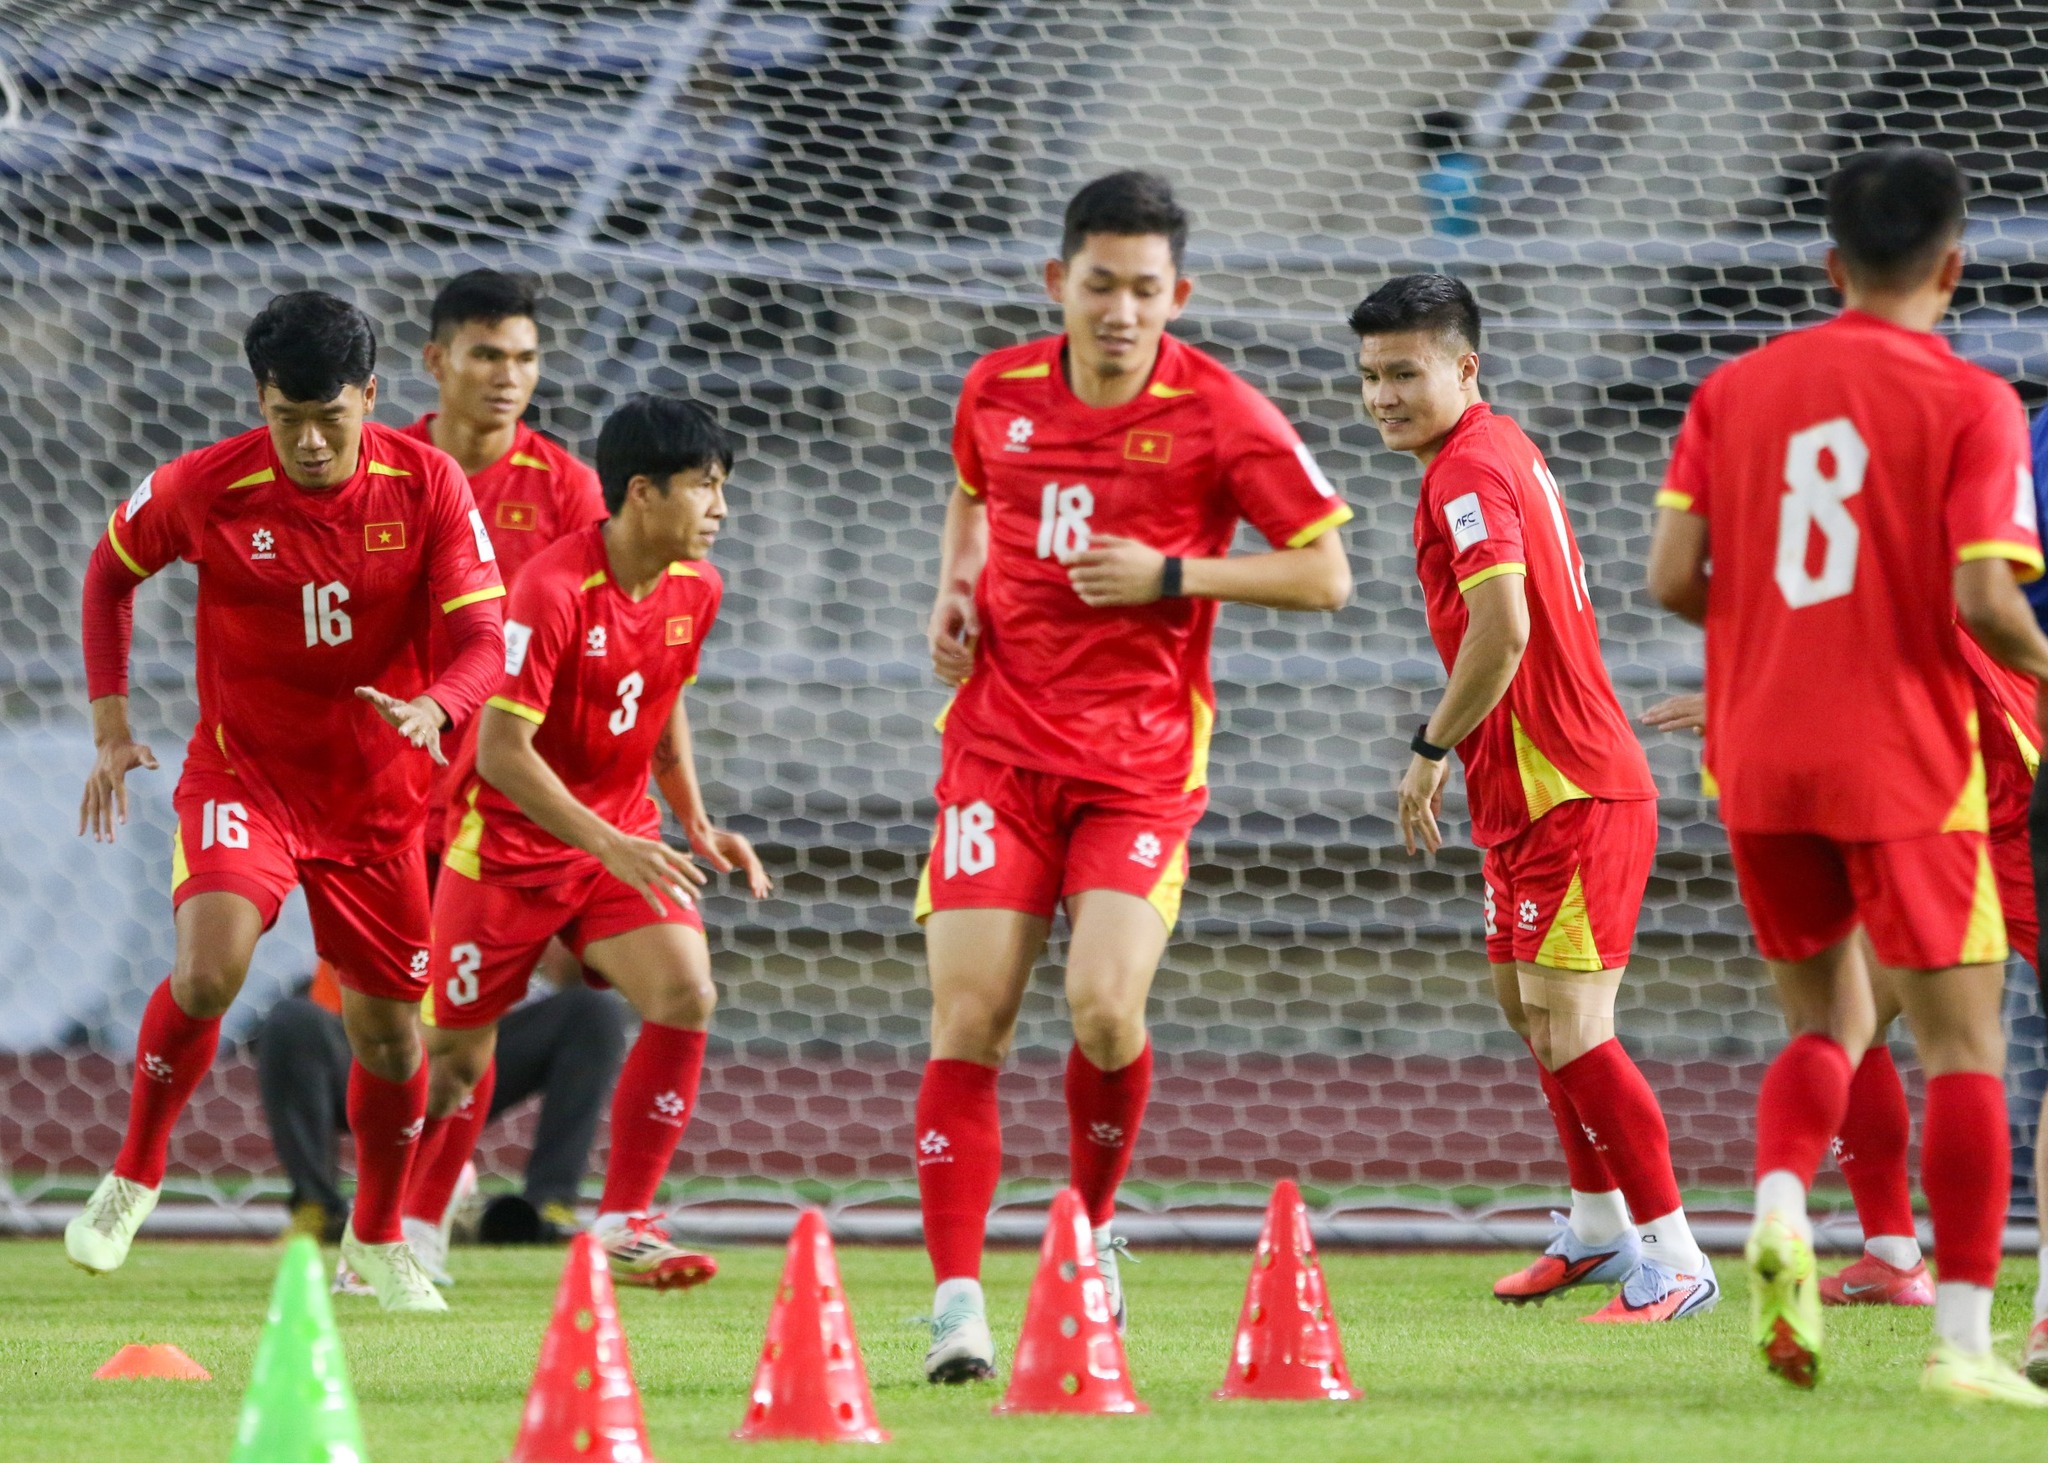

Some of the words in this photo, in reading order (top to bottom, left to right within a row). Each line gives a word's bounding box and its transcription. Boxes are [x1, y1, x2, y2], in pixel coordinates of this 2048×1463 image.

[1036, 482, 1094, 565] 18
[1455, 510, 1477, 532] AFC
[1774, 417, 1869, 609] 8
[302, 580, 352, 647] 16
[608, 671, 644, 736] 3
[201, 799, 250, 850] 16
[943, 800, 996, 880] 18
[447, 943, 482, 1006] 3
